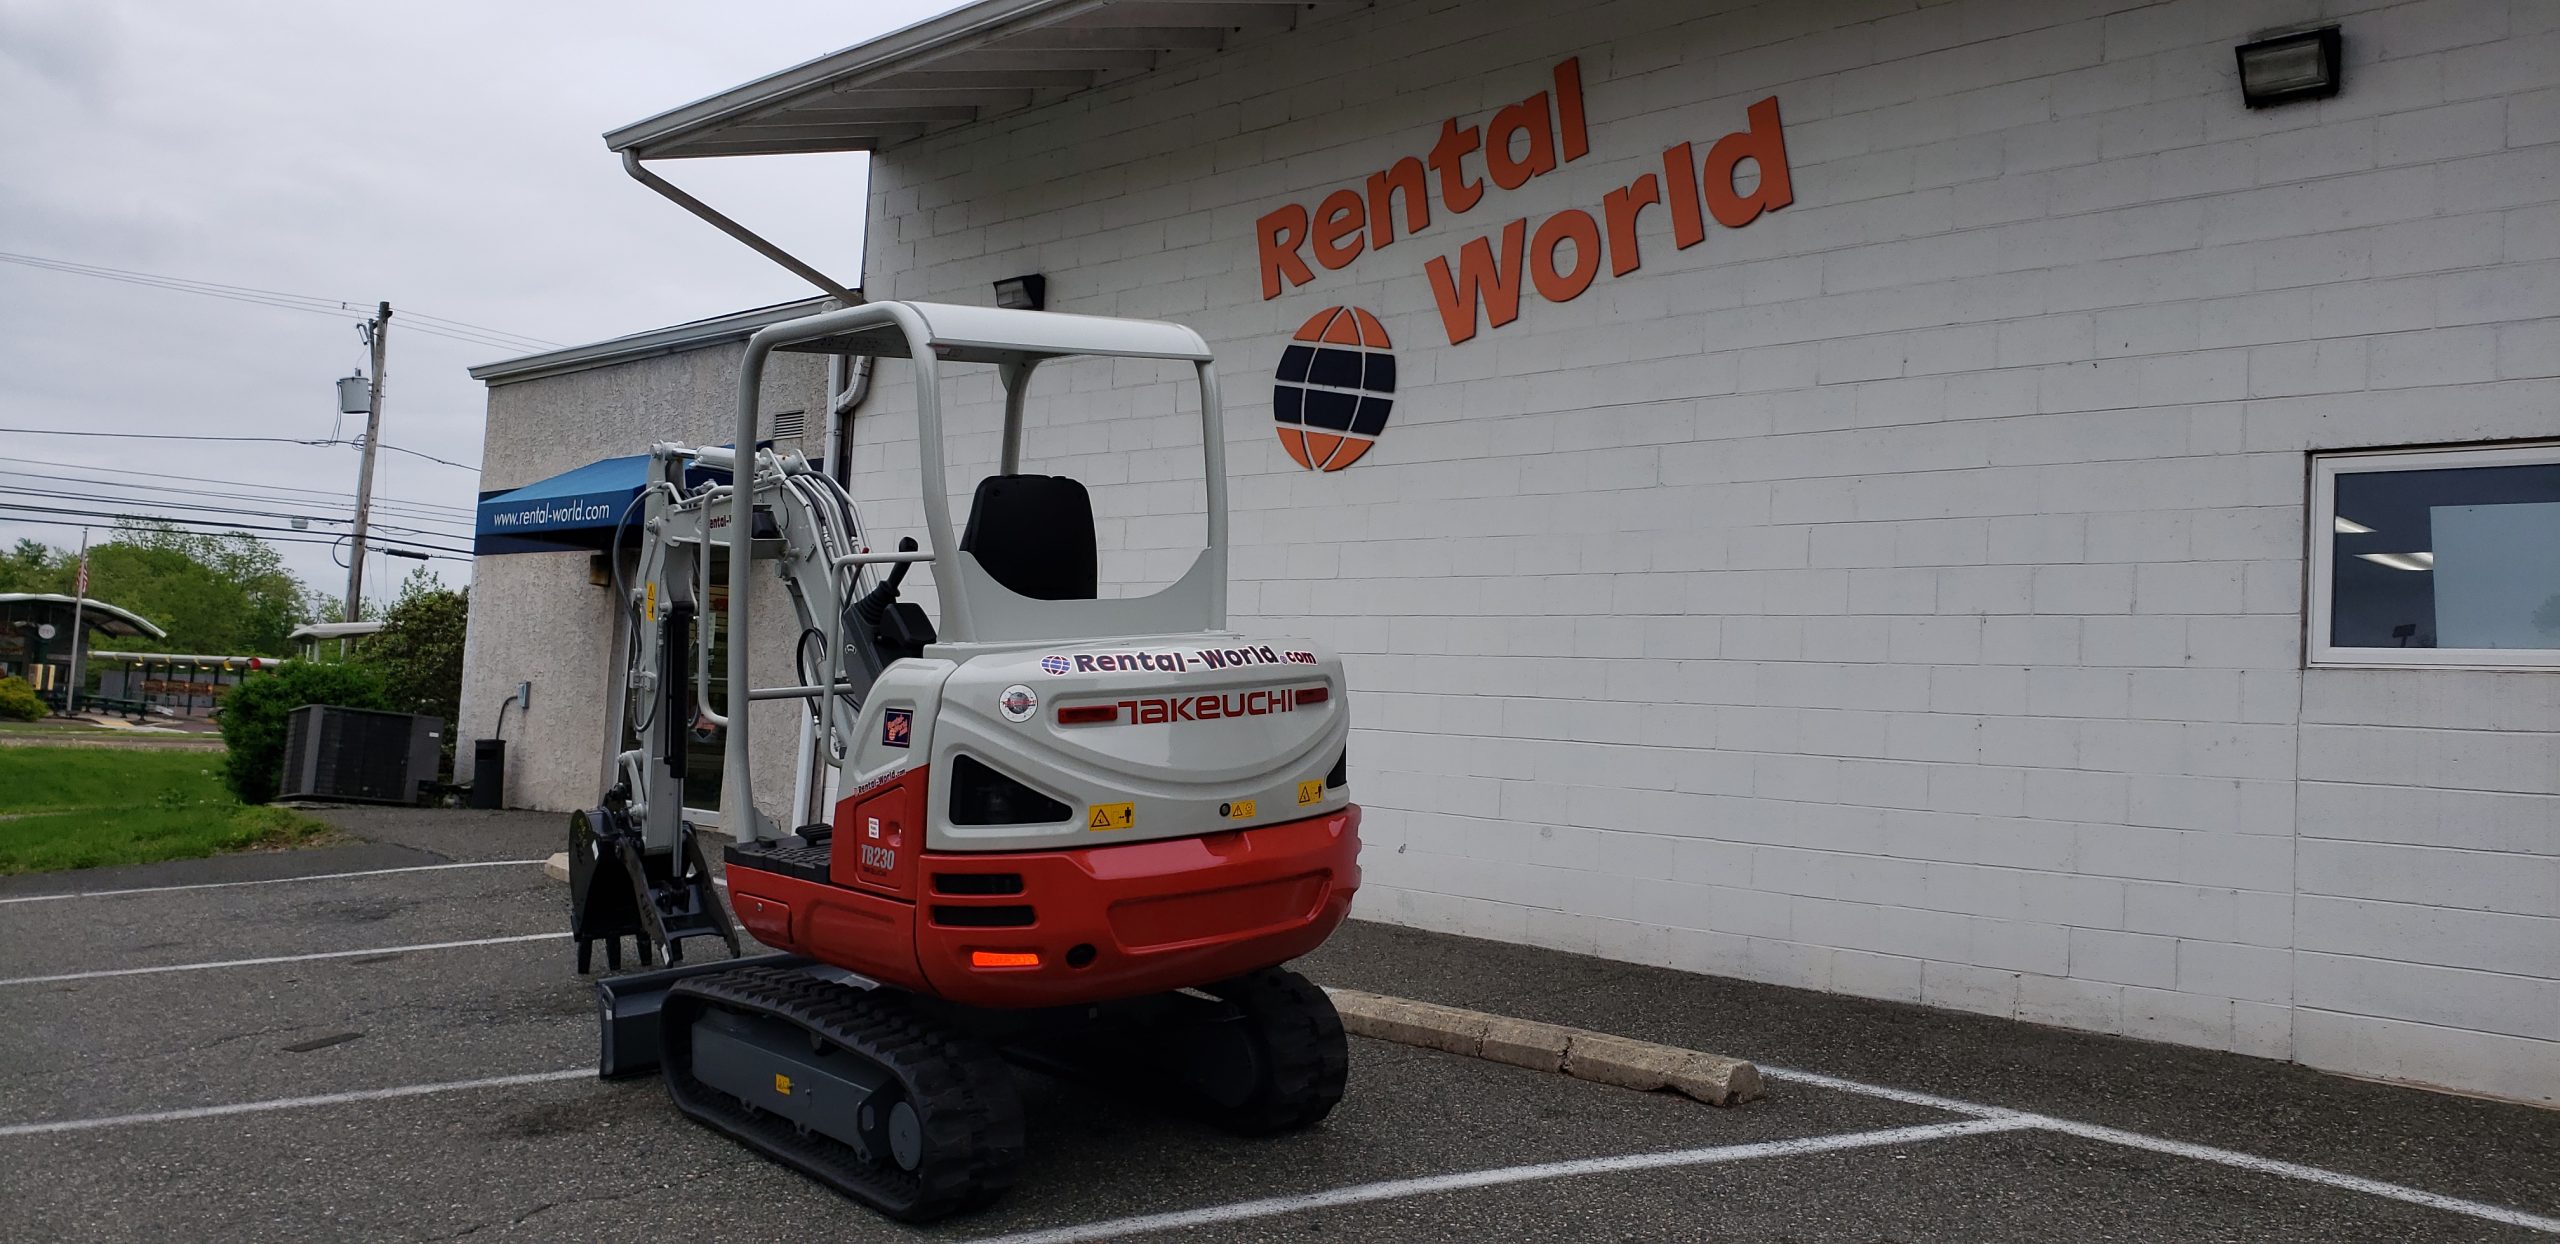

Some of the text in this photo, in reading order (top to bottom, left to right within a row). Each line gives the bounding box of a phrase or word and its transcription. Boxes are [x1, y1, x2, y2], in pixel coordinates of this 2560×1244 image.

[1256, 57, 1590, 301] Rental
[1424, 95, 1794, 346] World
[494, 499, 609, 526] www.rental-world.com
[1118, 688, 1293, 725] TAKEUCHI
[861, 844, 895, 870] TB230
